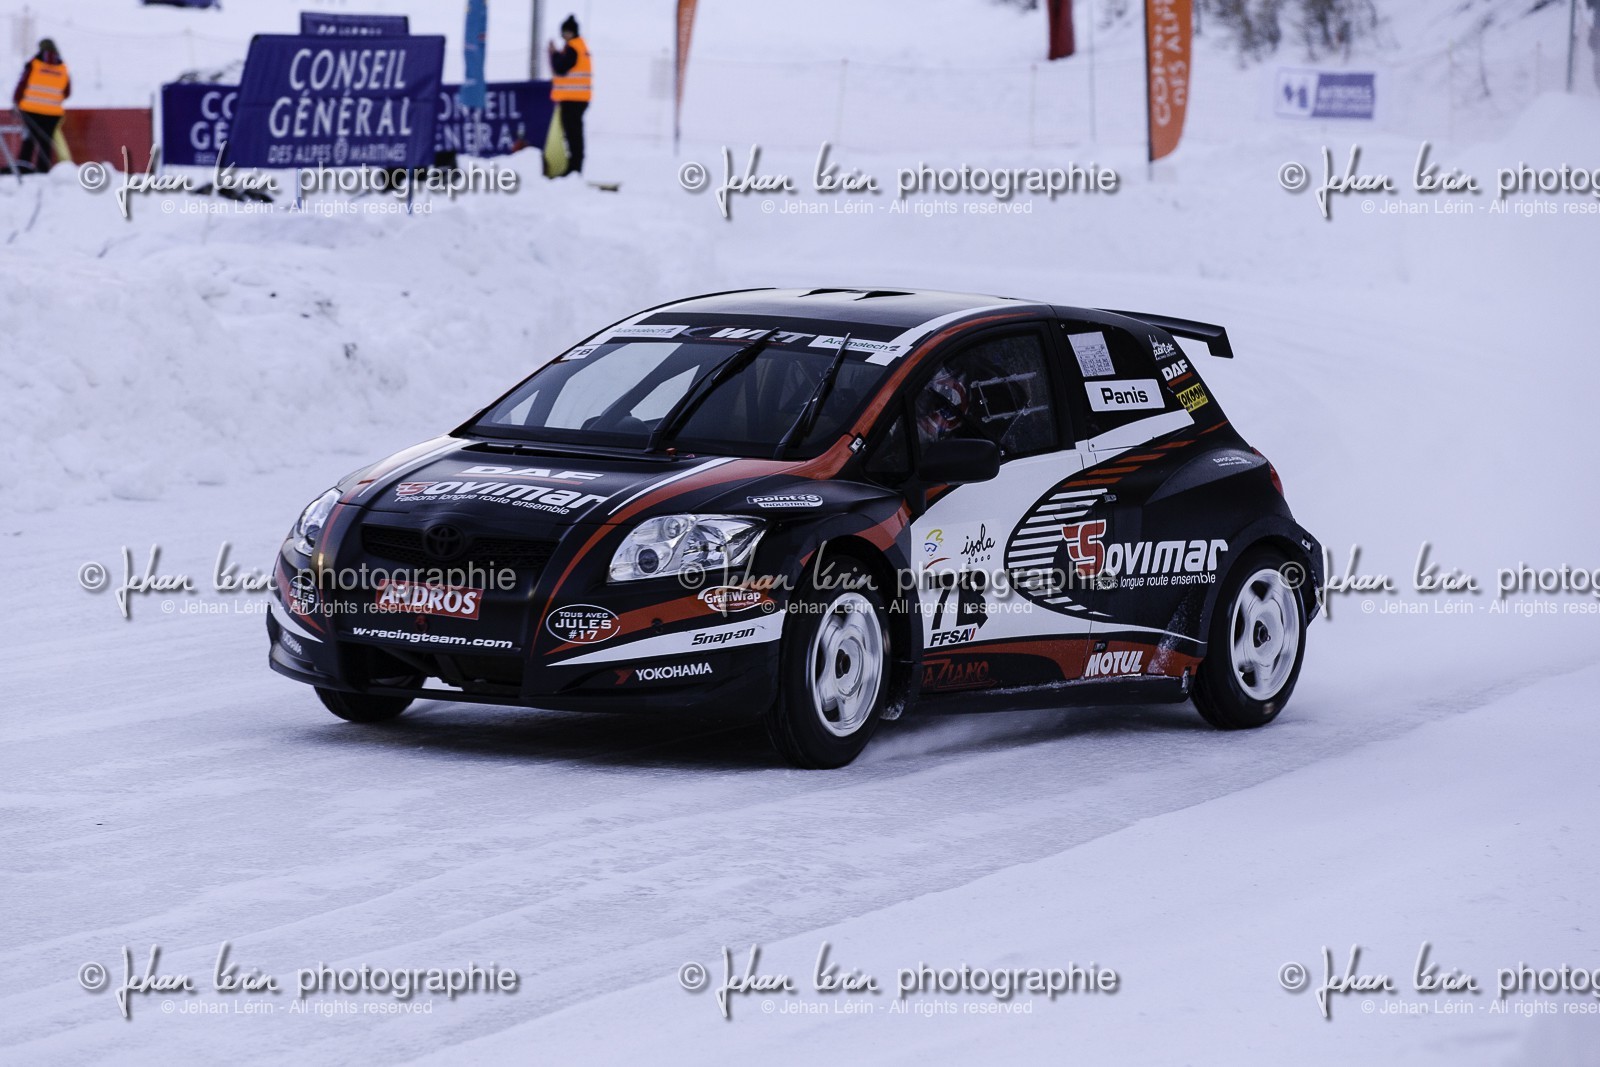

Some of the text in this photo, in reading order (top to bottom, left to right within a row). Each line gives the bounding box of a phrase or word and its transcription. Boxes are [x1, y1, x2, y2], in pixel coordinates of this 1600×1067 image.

[289, 48, 407, 90] CONSEIL
[269, 88, 412, 138] GÉNÉRAL
[1161, 359, 1188, 381] DAF
[1100, 387, 1149, 404] Panis
[461, 465, 604, 481] DAF
[438, 493, 477, 502] longue
[480, 493, 511, 505] route
[512, 499, 570, 516] ensemble
[960, 523, 996, 555] isola
[1120, 576, 1145, 590] longue
[1147, 574, 1169, 586] route
[1171, 571, 1216, 585] ensemble
[379, 583, 478, 615] ANDROS
[555, 618, 612, 630] JULES
[352, 626, 513, 649] w-racingteam.com
[568, 629, 598, 640] #17
[691, 627, 756, 646] Snap-on
[929, 629, 970, 647] FFSA
[636, 662, 713, 681] YOKOHAMA
[1085, 650, 1144, 678] MOTUL
